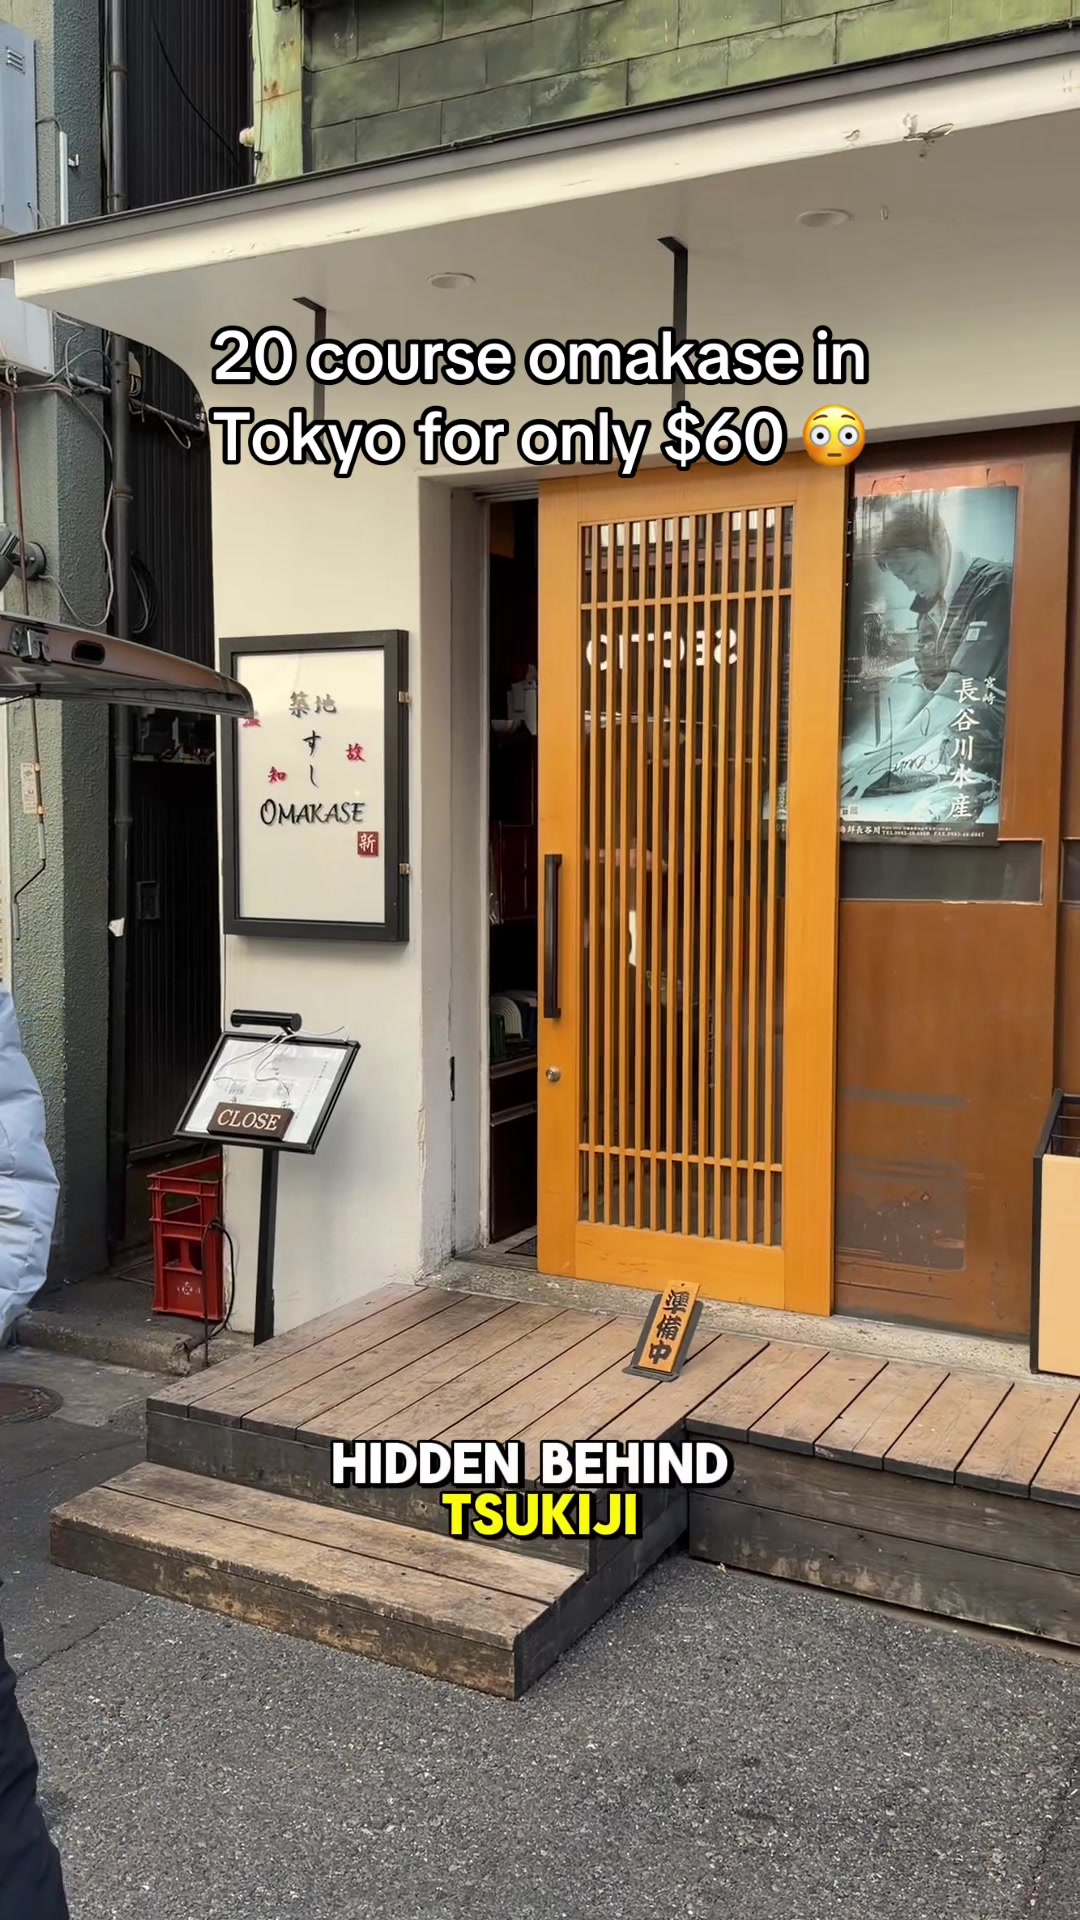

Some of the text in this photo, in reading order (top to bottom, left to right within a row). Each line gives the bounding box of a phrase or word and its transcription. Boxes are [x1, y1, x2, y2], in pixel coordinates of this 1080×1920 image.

[288, 691, 337, 718] 築地
[302, 729, 322, 788] すし
[345, 743, 366, 762] 故
[951, 677, 981, 819] 長谷川水産
[267, 766, 287, 784] 知
[259, 798, 366, 826] OMAKASE
[358, 832, 376, 854] 新
[217, 1108, 281, 1131] CLOSE
[648, 1289, 690, 1365] 準備中
